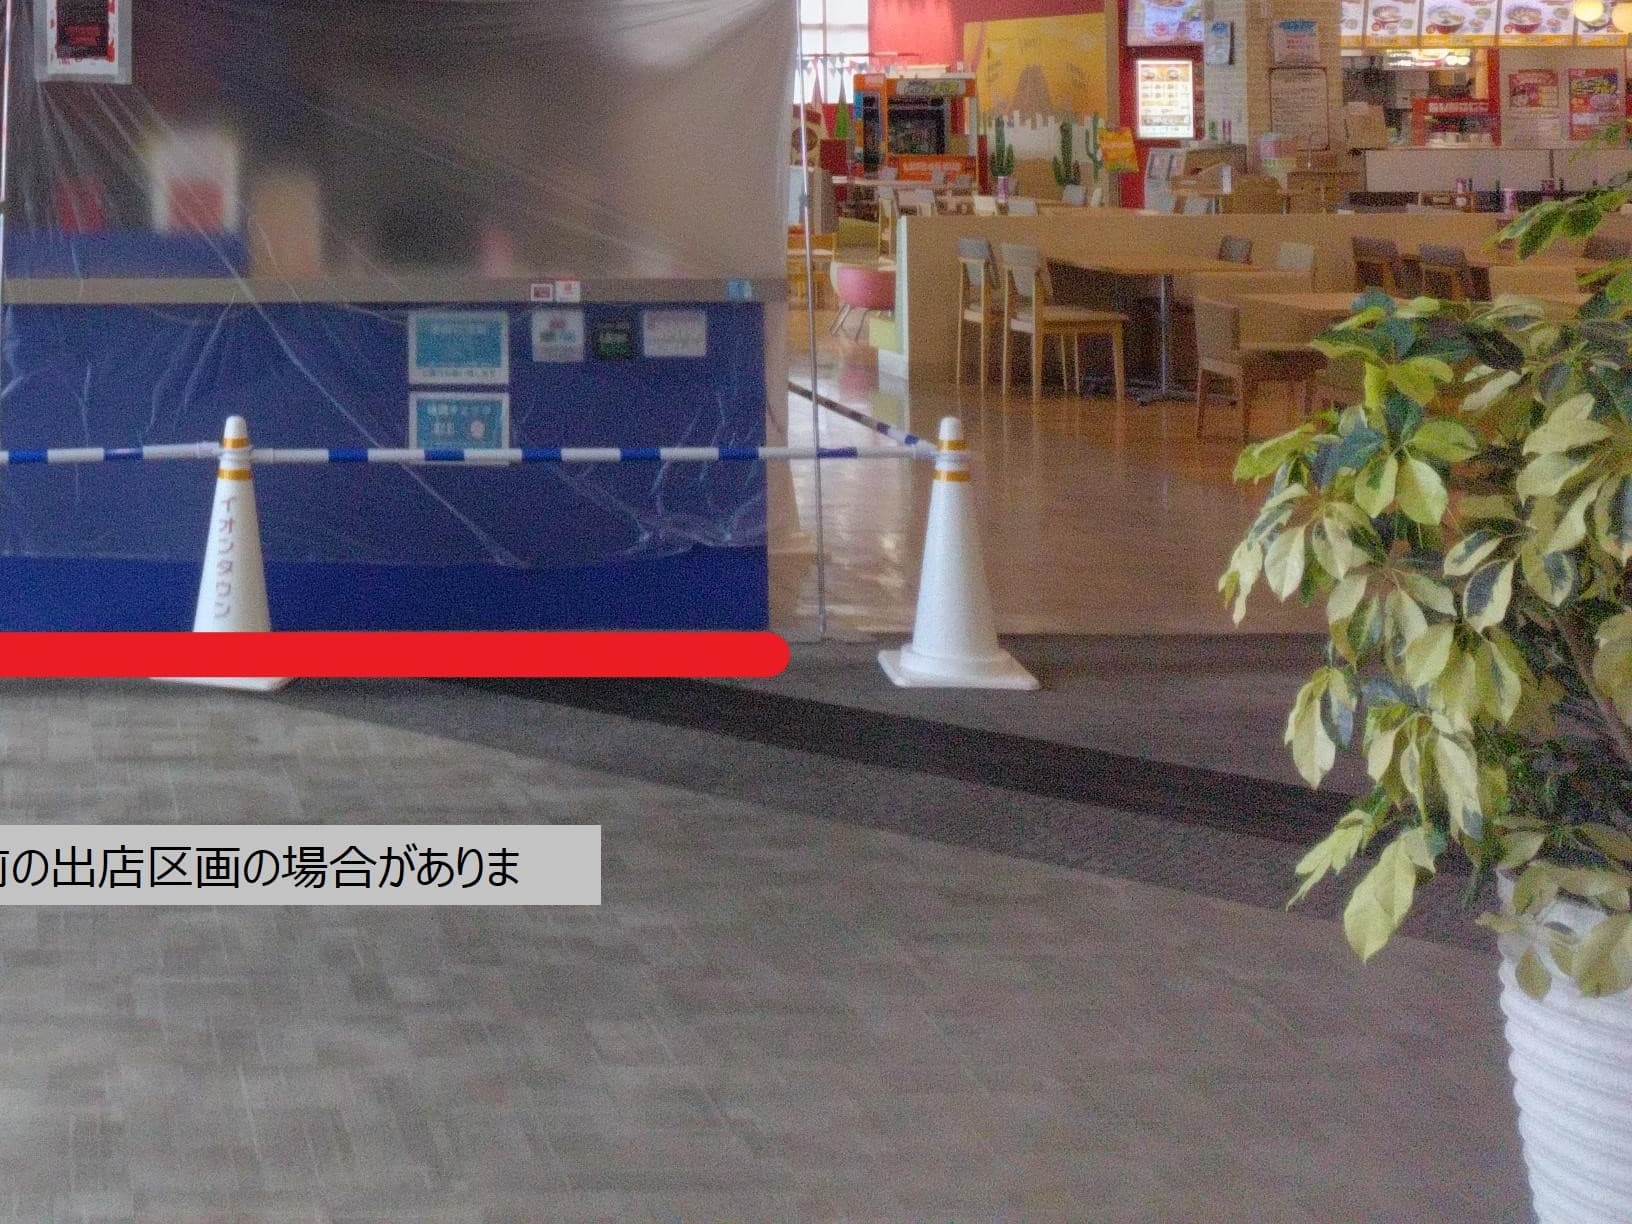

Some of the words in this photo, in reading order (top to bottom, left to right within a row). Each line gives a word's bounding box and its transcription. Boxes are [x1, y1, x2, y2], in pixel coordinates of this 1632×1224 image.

[214, 495, 239, 619] イオンタウン
